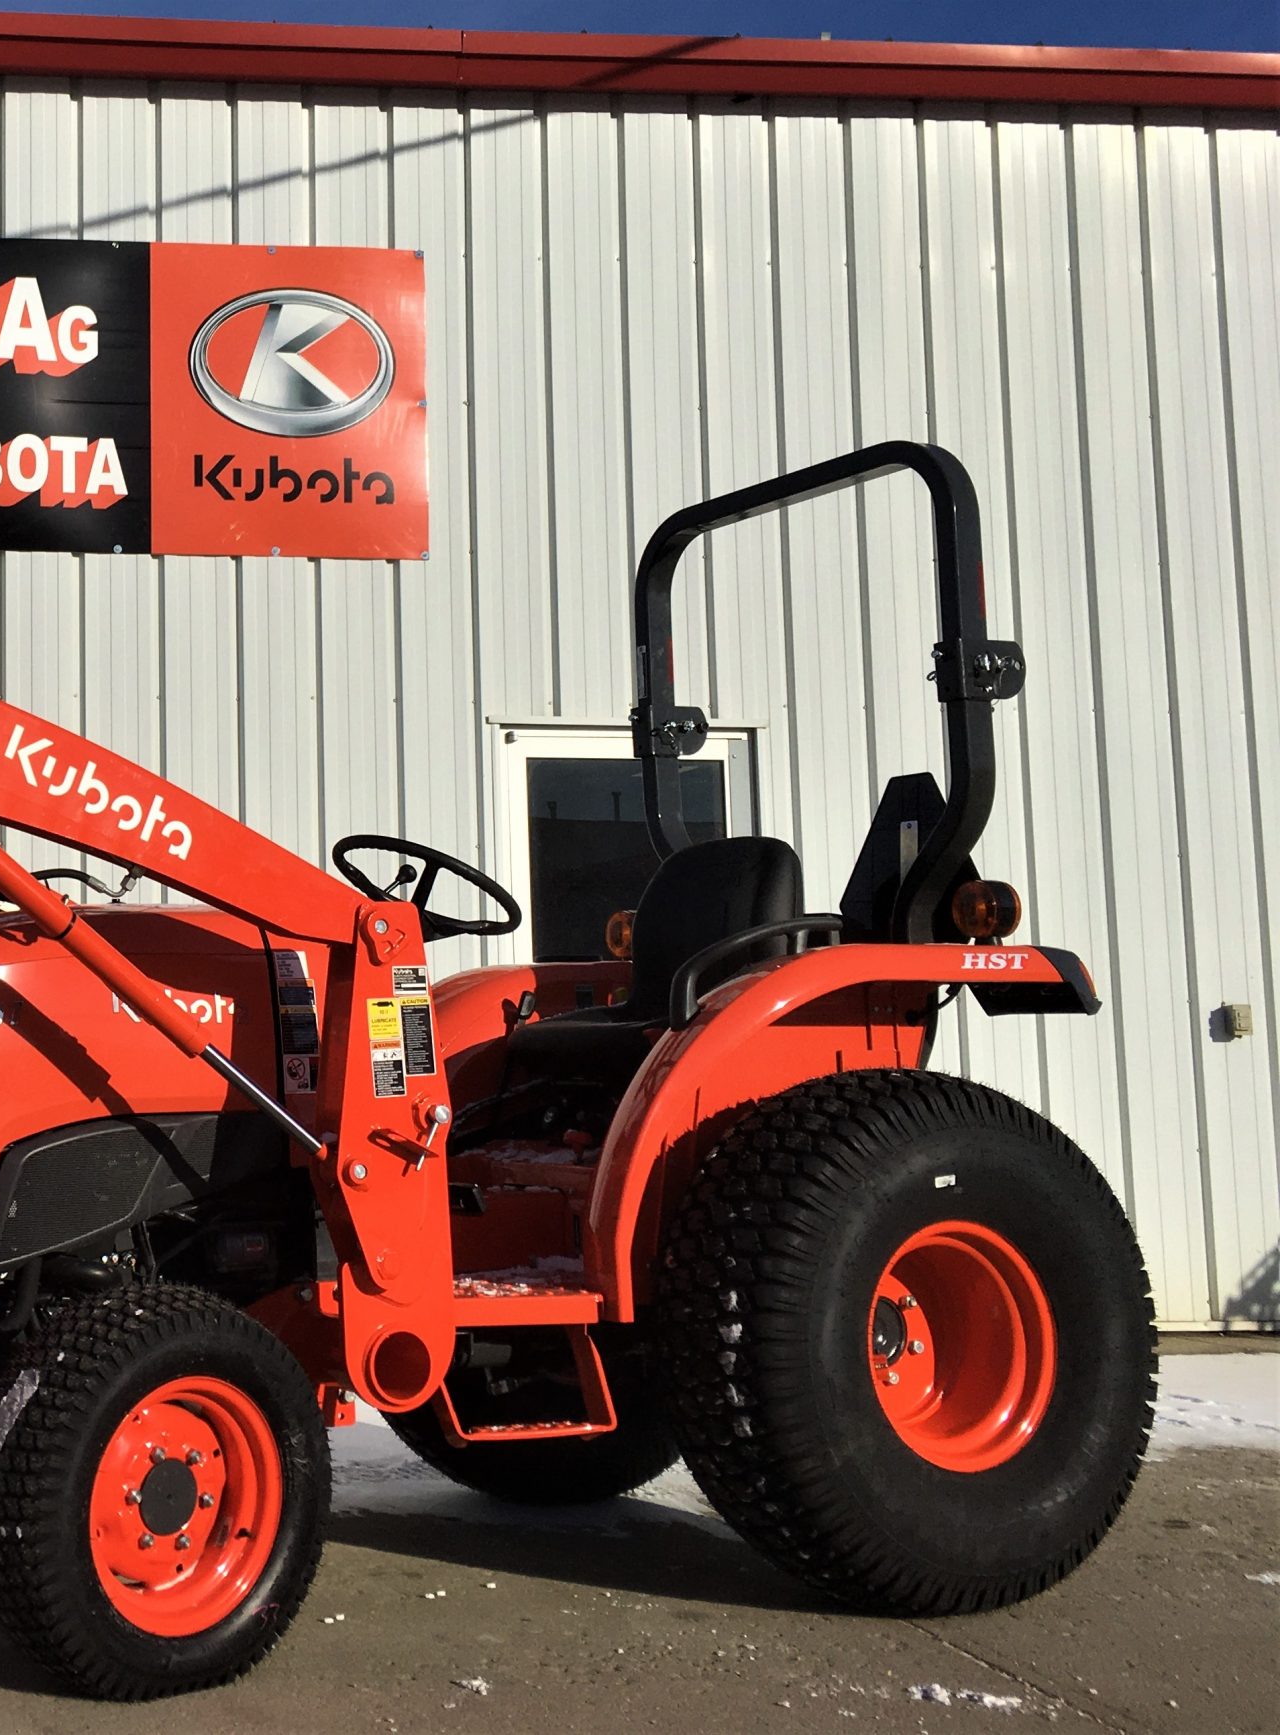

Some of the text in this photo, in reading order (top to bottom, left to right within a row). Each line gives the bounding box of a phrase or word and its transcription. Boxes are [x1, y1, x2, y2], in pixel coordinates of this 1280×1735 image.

[194, 454, 394, 504] Kubota
[4, 724, 193, 860] Kubota
[961, 953, 1028, 970] HST
